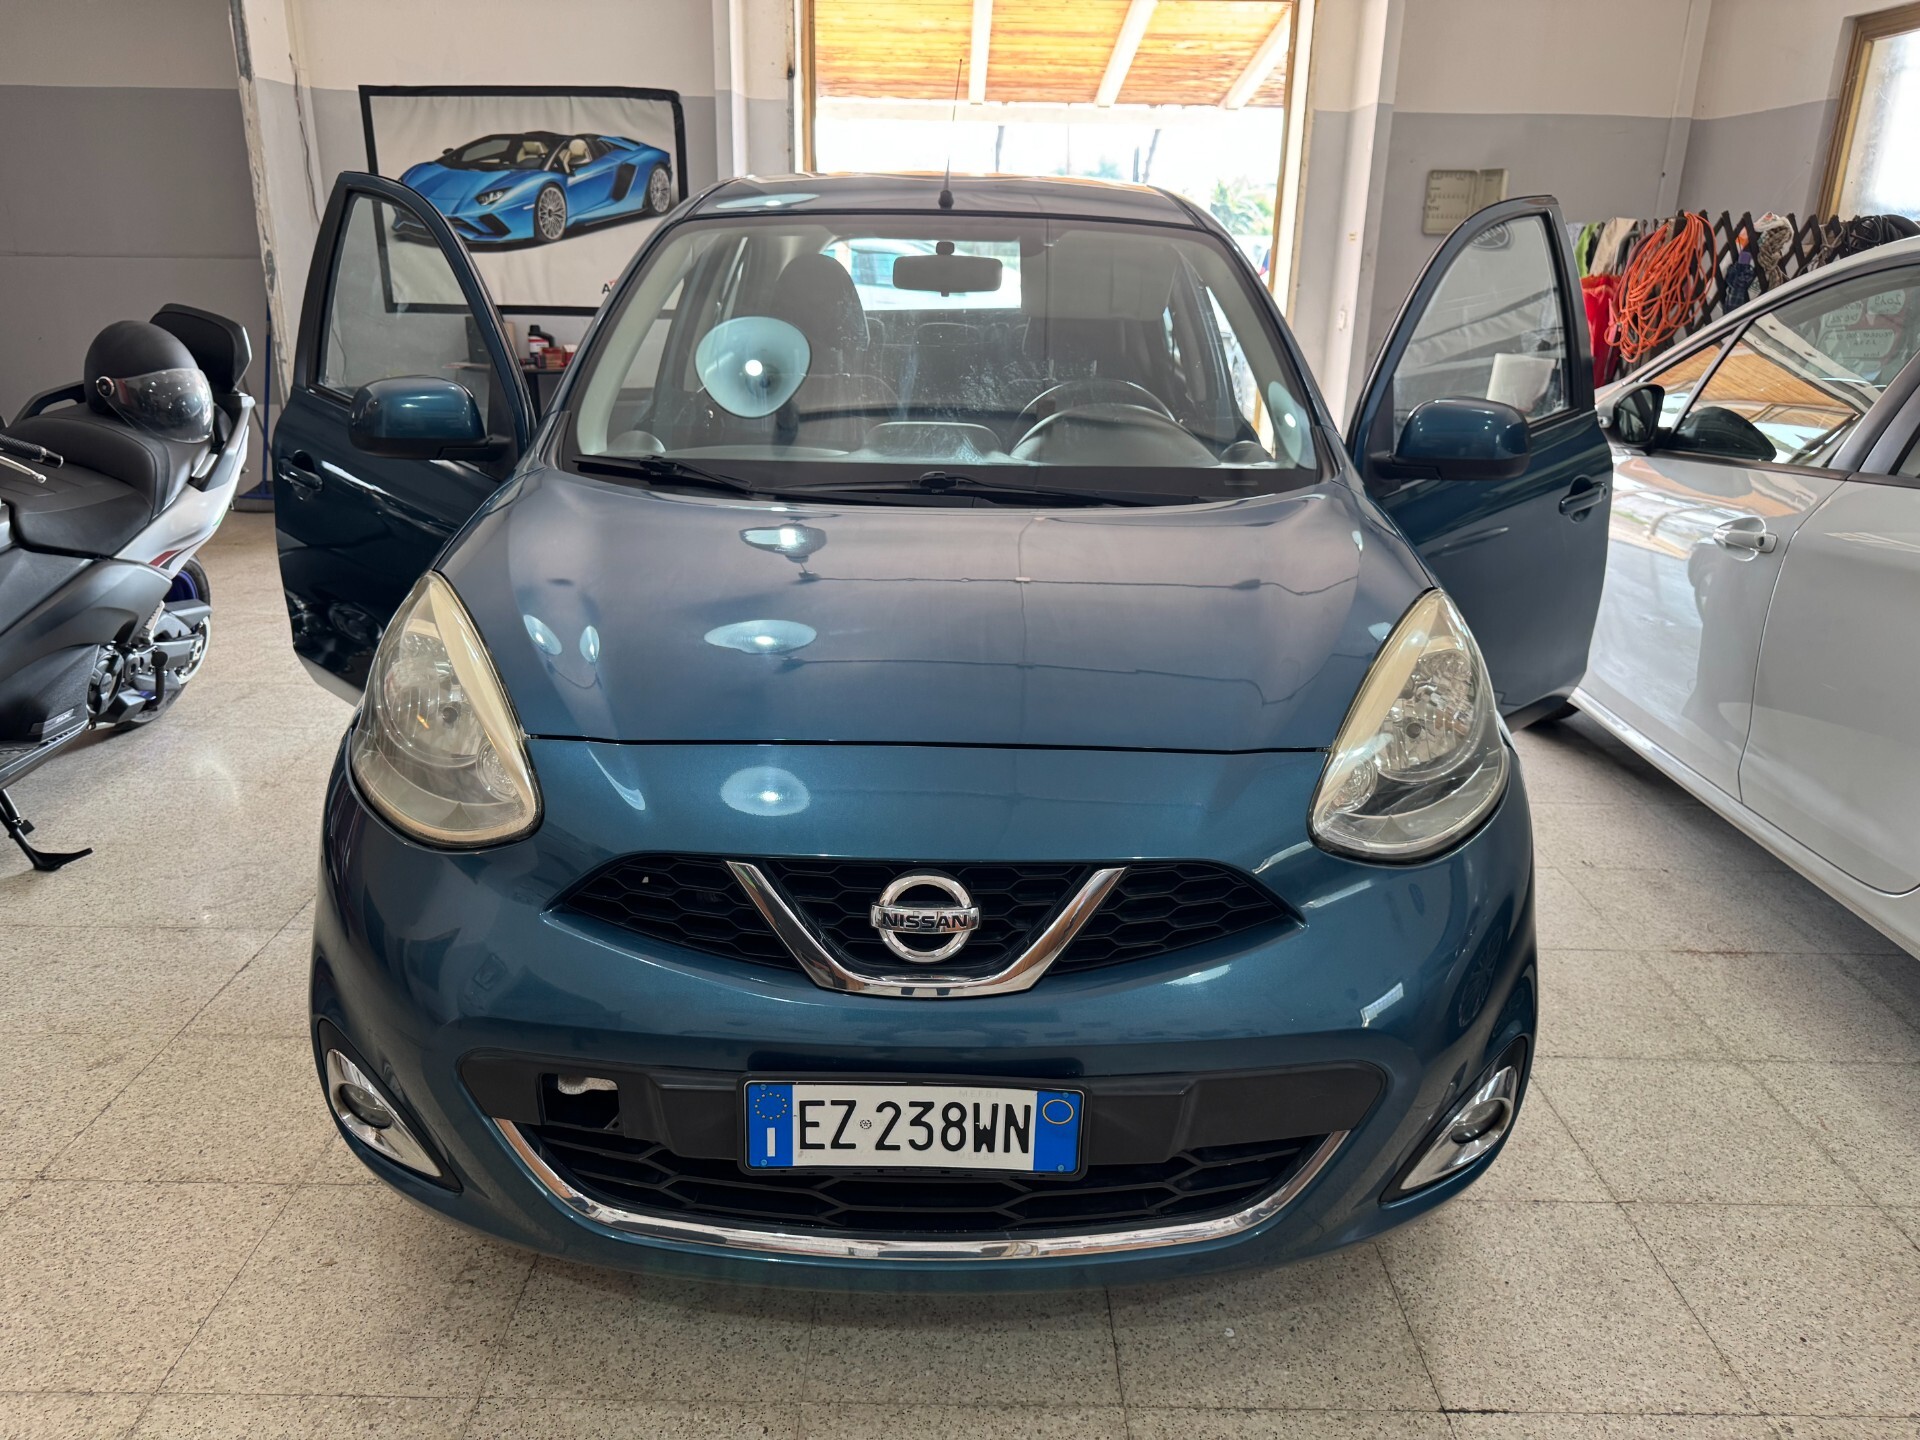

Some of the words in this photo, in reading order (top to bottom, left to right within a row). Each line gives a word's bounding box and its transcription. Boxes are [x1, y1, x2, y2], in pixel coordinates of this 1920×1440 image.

[882, 912, 968, 929] NISSAN
[799, 1100, 857, 1150] EZ
[875, 1101, 1031, 1153] 238WN
[766, 1127, 776, 1157] I
